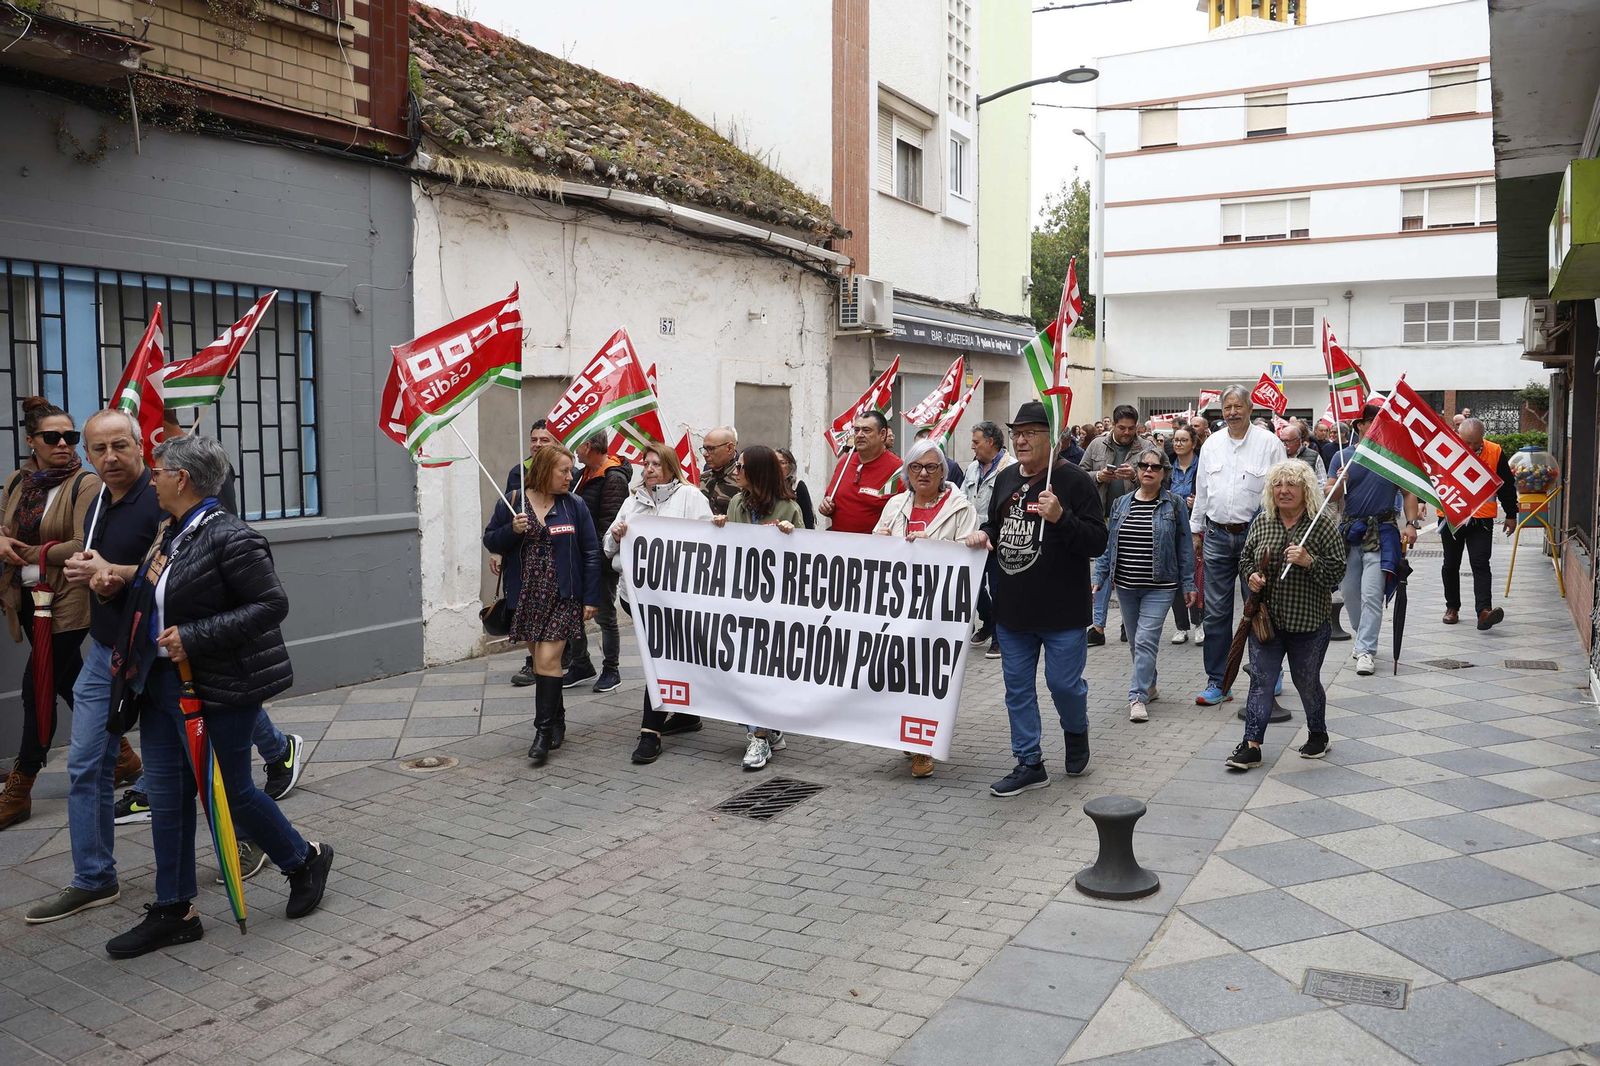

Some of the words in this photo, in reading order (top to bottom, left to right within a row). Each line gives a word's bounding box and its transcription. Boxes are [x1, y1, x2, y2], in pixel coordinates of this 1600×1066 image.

[662, 320, 673, 332] 57
[931, 330, 943, 342] BAR
[632, 536, 727, 597] CONTRA
[731, 546, 776, 603] LOS
[780, 551, 907, 619] RECORTES
[907, 563, 940, 621] EN
[941, 565, 972, 623] LA
